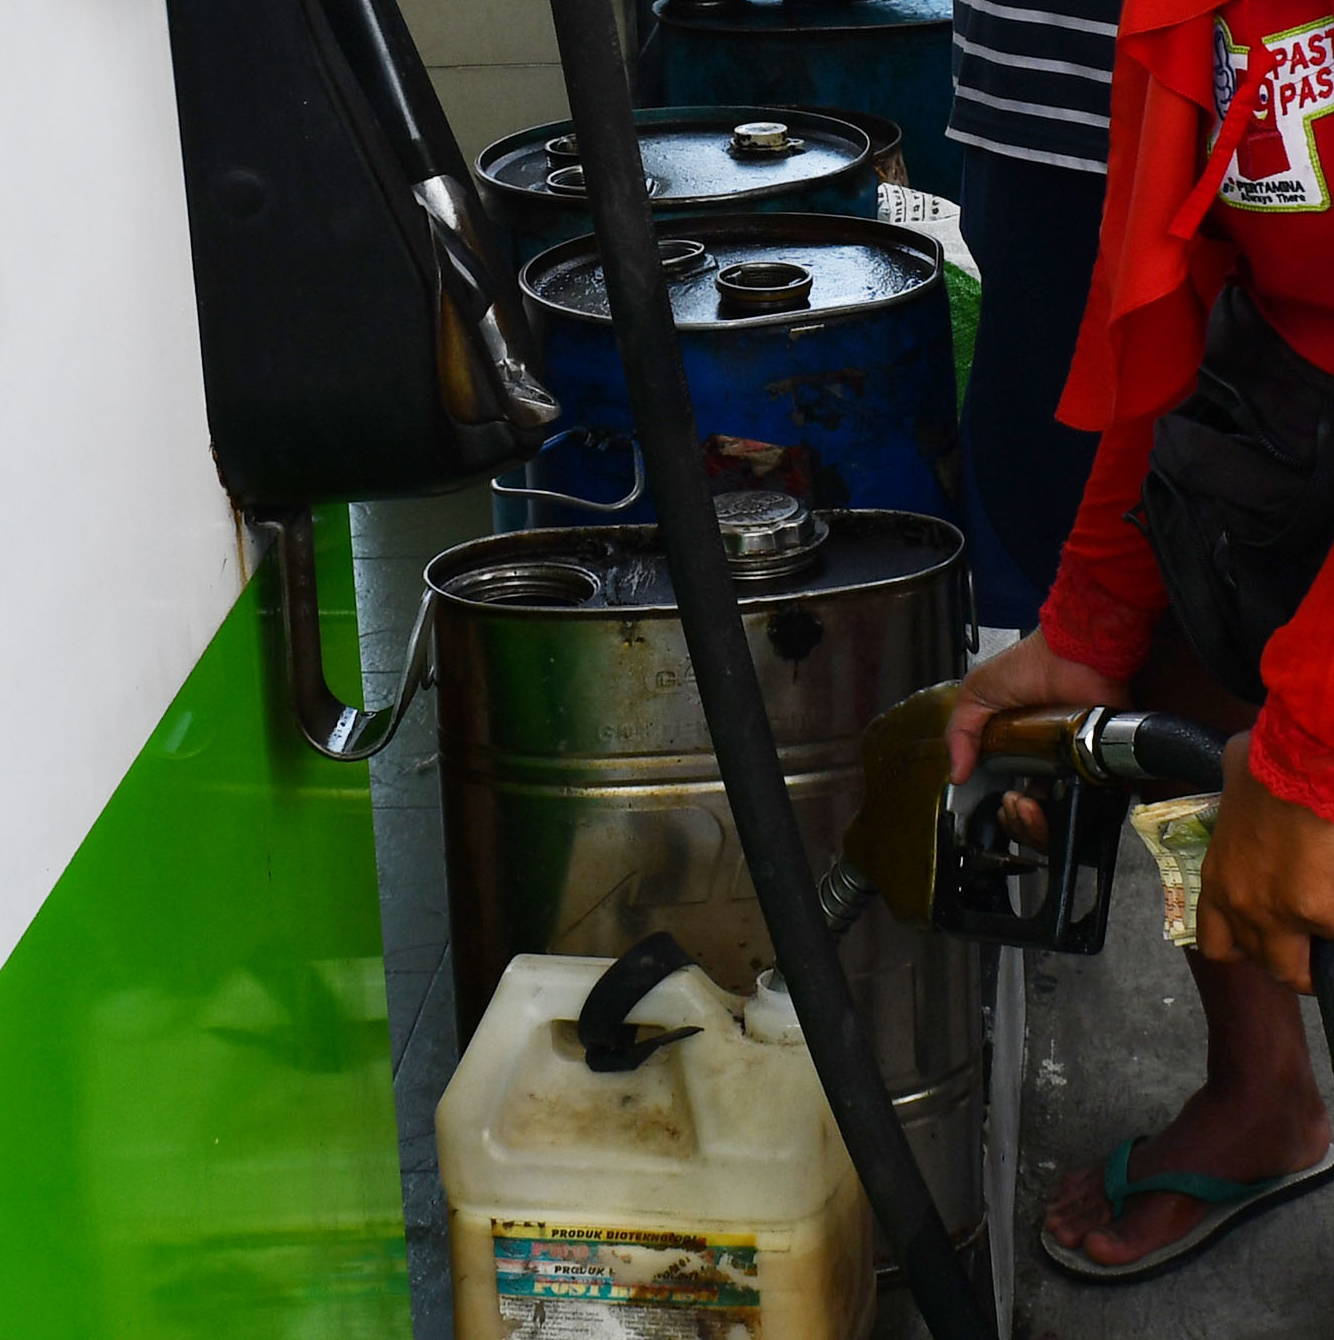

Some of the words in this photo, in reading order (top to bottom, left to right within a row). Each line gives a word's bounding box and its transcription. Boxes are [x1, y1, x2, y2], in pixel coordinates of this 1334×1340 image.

[1235, 180, 1306, 195] PERTAMINA
[1276, 193, 1306, 203] There
[551, 1229, 603, 1240] PRODUK
[554, 1265, 605, 1276] PRODUK
